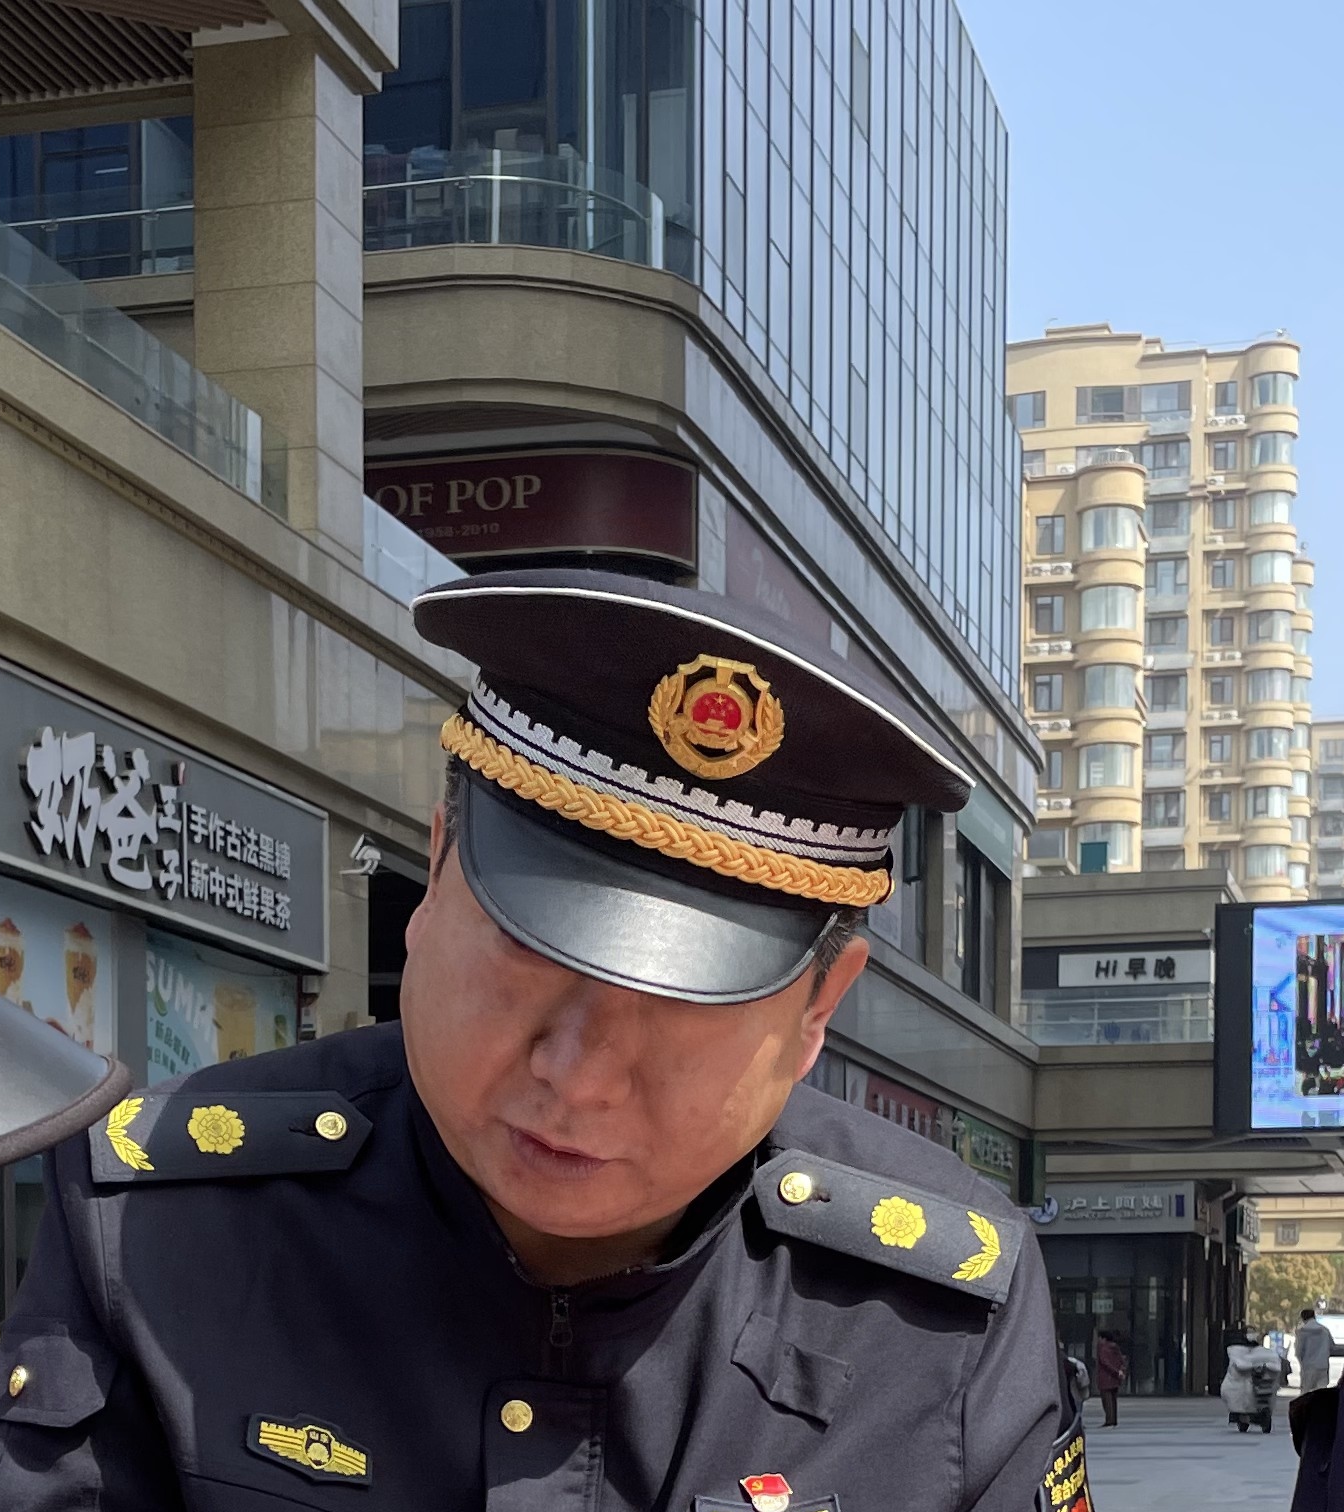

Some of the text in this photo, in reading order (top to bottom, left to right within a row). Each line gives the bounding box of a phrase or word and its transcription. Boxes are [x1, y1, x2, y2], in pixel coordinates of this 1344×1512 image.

[374, 474, 542, 518] OF POP
[22, 725, 157, 891] 奶爸
[189, 803, 292, 881] 手作古法黑糖
[189, 857, 292, 931] 新中式鲜果茶
[1124, 956, 1177, 981] 早晚
